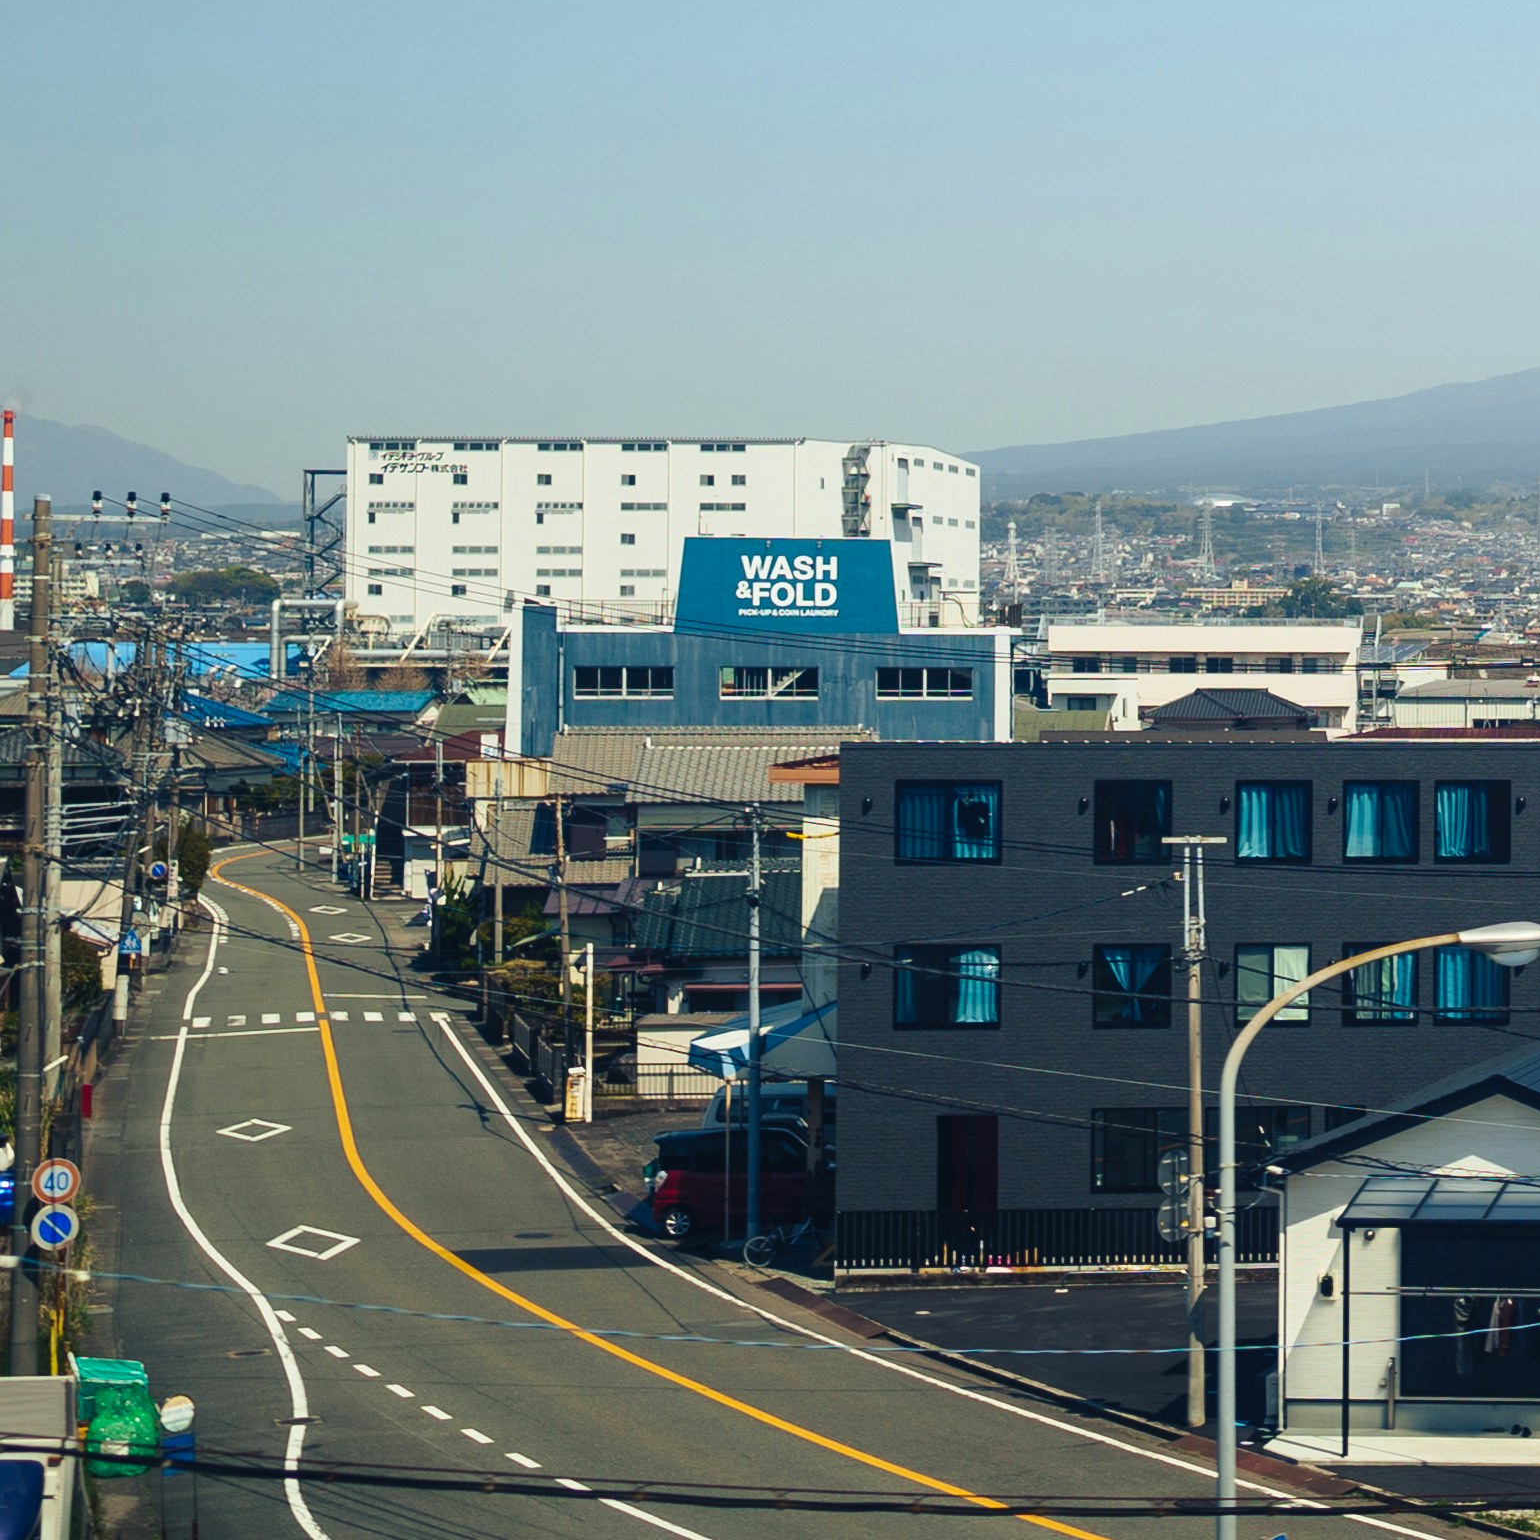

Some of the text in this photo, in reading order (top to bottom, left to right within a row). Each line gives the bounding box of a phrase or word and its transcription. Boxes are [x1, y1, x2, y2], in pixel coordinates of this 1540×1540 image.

[741, 555, 838, 580] WASH
[735, 580, 838, 607] &FOLD
[738, 608, 772, 616] PICK-UP
[800, 609, 839, 617] LAUNDRY
[44, 1171, 69, 1191] 40
